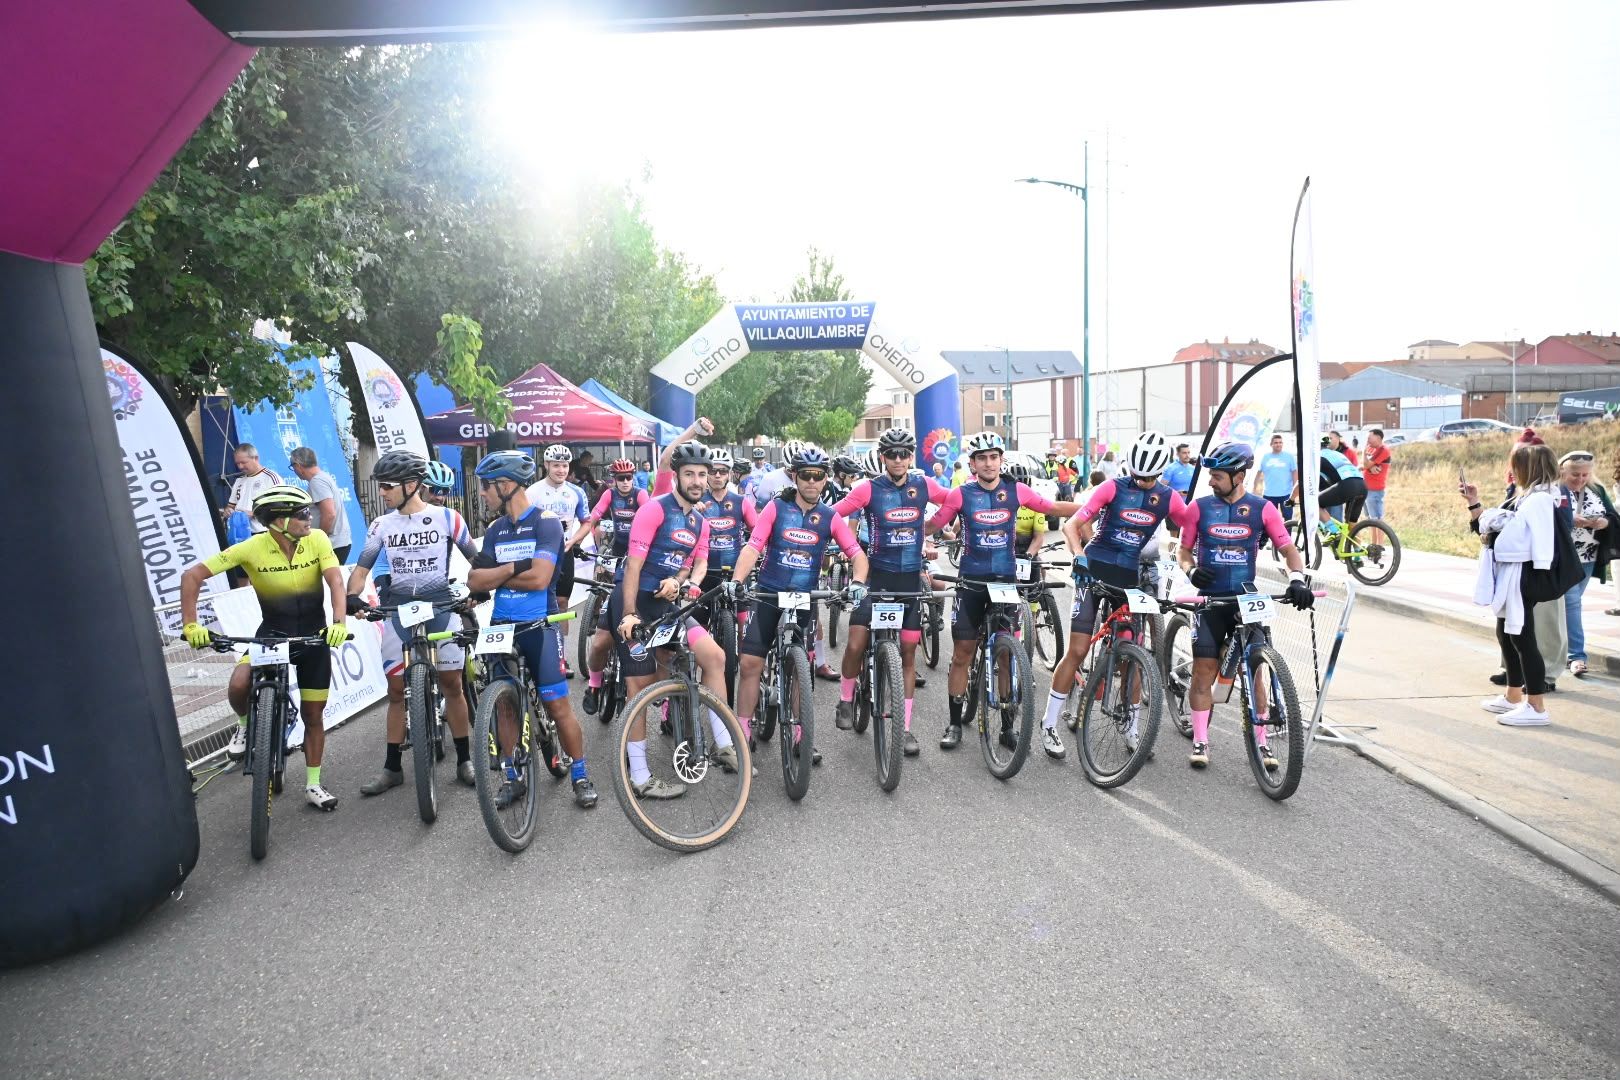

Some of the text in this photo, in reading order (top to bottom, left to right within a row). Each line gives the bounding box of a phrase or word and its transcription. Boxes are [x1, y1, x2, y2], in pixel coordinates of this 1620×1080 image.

[742, 305, 870, 321] AYUNTAMIENTO DE
[747, 323, 866, 341] VILLAQUILAMBRE
[684, 338, 741, 386] CHEMO
[870, 334, 925, 384] CHEMO
[1126, 512, 1150, 522] MAUCO
[388, 530, 440, 548] MACHO
[789, 532, 813, 540] MAUCO
[411, 605, 419, 613] 9
[1247, 600, 1266, 612] 29
[879, 612, 896, 621] 56
[485, 633, 505, 643] 89
